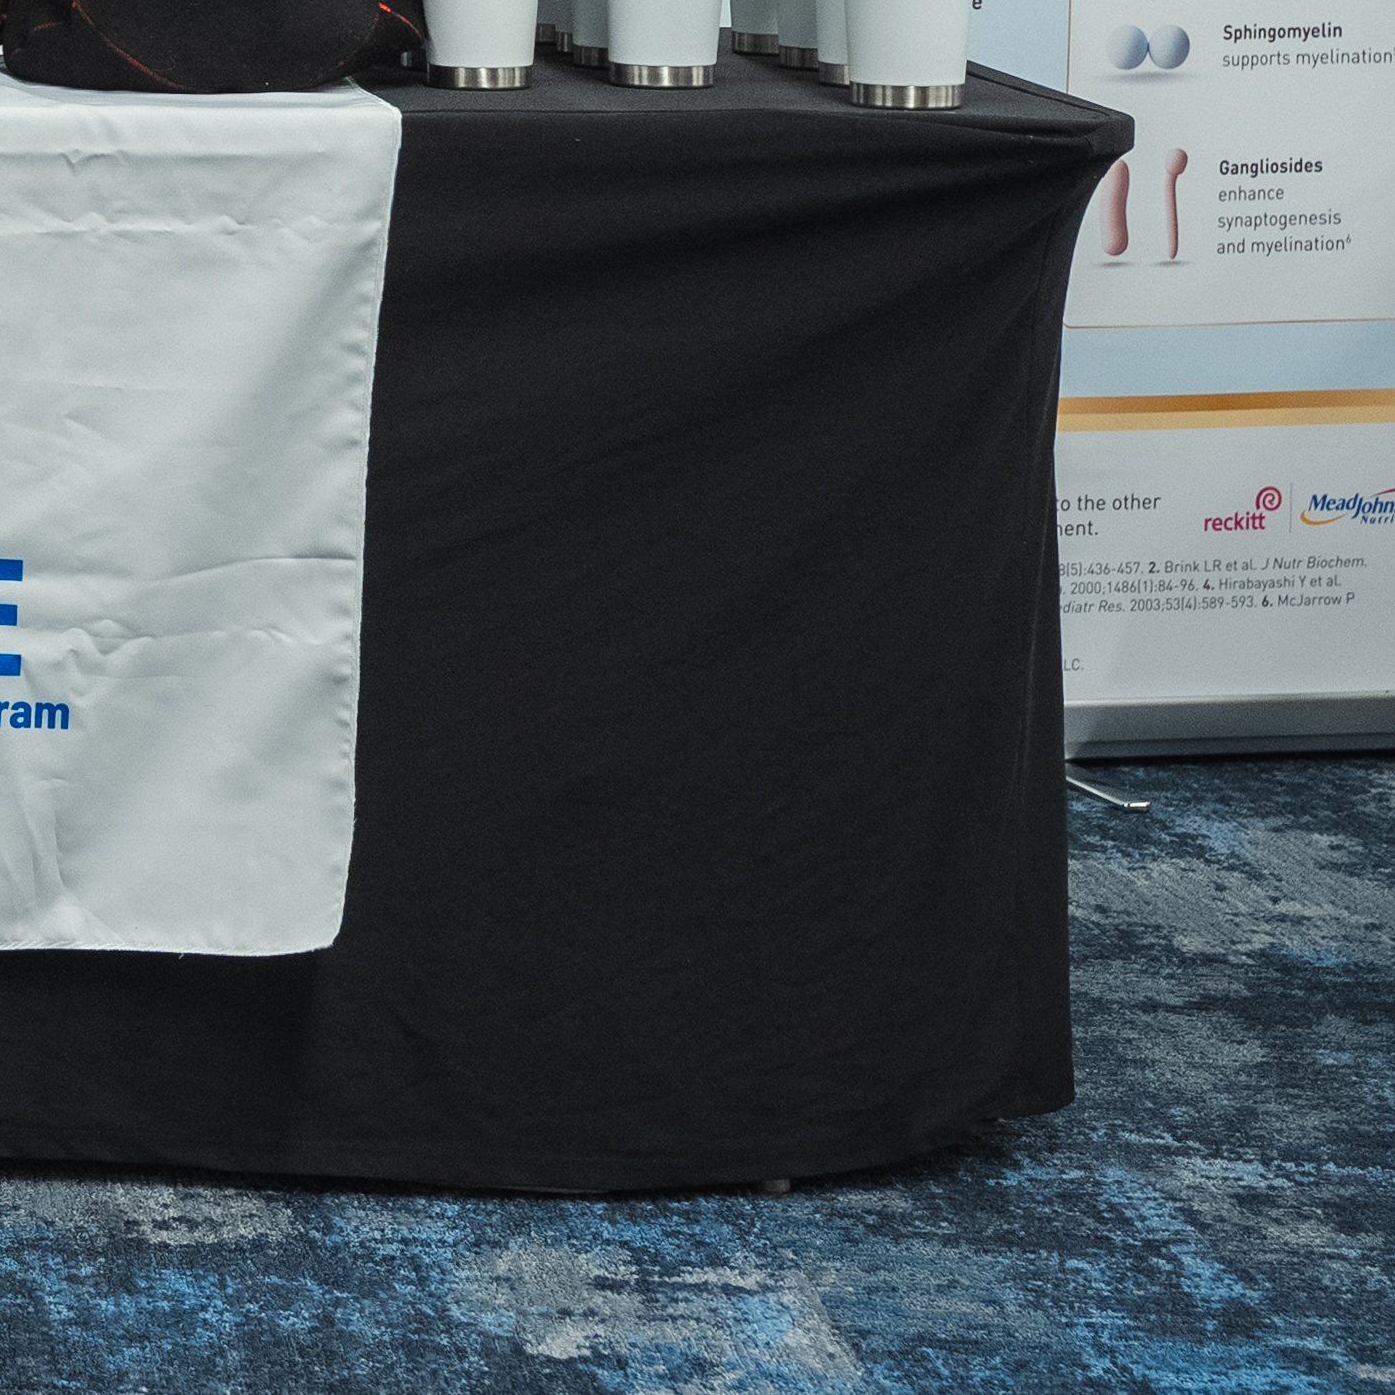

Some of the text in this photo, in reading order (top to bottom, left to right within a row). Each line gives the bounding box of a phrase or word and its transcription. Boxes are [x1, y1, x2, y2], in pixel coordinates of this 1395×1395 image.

[1222, 22, 1343, 44] Sphingomyelin
[1221, 49, 1291, 70] supports
[1218, 157, 1323, 179] Gangliosides
[1217, 185, 1285, 203] enhance
[1216, 209, 1342, 232] synaptogenesis
[1216, 238, 1246, 255] and
[1077, 494, 1106, 511] the
[1111, 493, 1161, 512] other
[1308, 492, 1395, 520] MeadJohn
[1203, 510, 1266, 532] reckitt
[1148, 561, 1160, 574] 2.
[1164, 560, 1200, 574] Brink
[1204, 559, 1221, 572] LR
[1225, 560, 1238, 572] et
[1241, 559, 1257, 571] al.
[1261, 558, 1270, 571] J
[1272, 557, 1303, 570] Nutr
[1306, 556, 1367, 570] Biochem.
[1202, 578, 1215, 591] 4.
[1218, 575, 1295, 591] Hirabayashi
[1298, 575, 1307, 586] Y
[1309, 575, 1323, 587] et
[1326, 574, 1342, 587] al.
[1059, 601, 1095, 613] diatr
[1097, 599, 1126, 613] Res.
[1261, 595, 1273, 607] 6.
[1277, 593, 1342, 607] McJarrow
[1346, 592, 1355, 605] P
